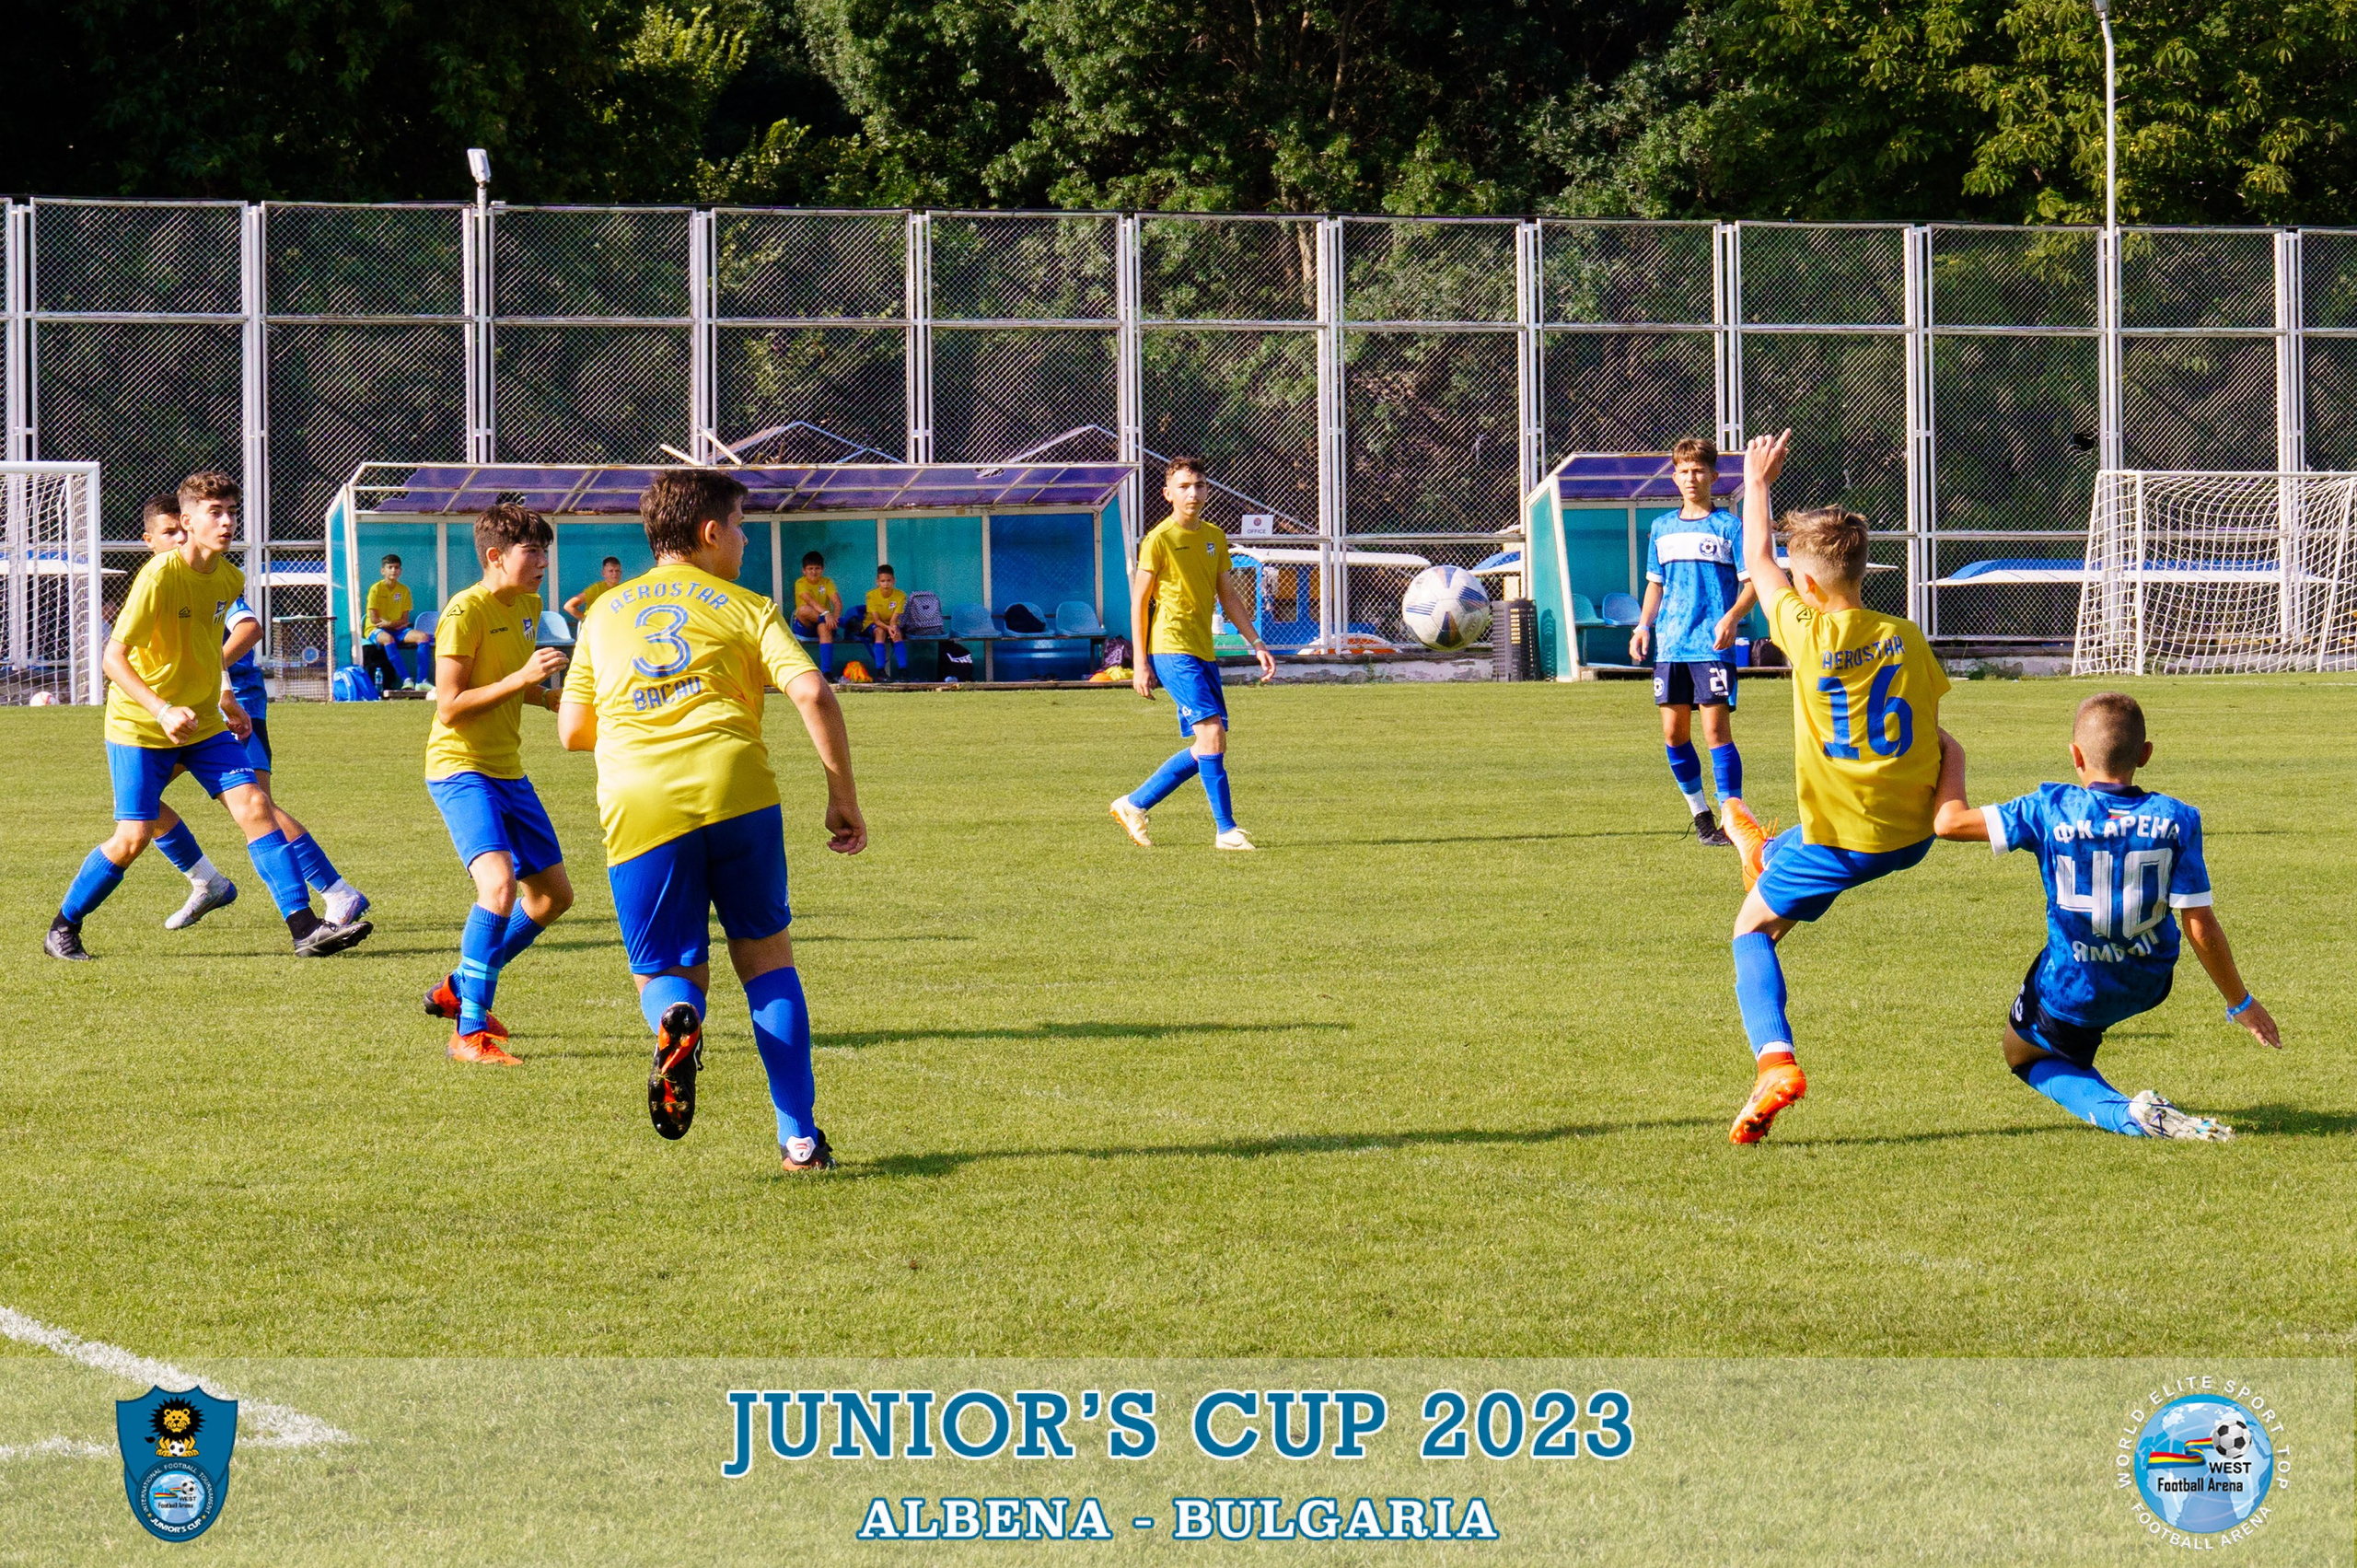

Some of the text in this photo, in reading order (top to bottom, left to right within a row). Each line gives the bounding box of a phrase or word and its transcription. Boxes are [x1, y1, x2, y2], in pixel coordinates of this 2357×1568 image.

[610, 581, 729, 614] AEROSTAR
[633, 604, 691, 678] 3
[1822, 635, 1905, 669] AEROSTAR
[632, 676, 702, 712] BACAU
[1817, 663, 1913, 761] 16
[2053, 815, 2180, 843] ФК АРЕНА
[2056, 847, 2173, 940] 40
